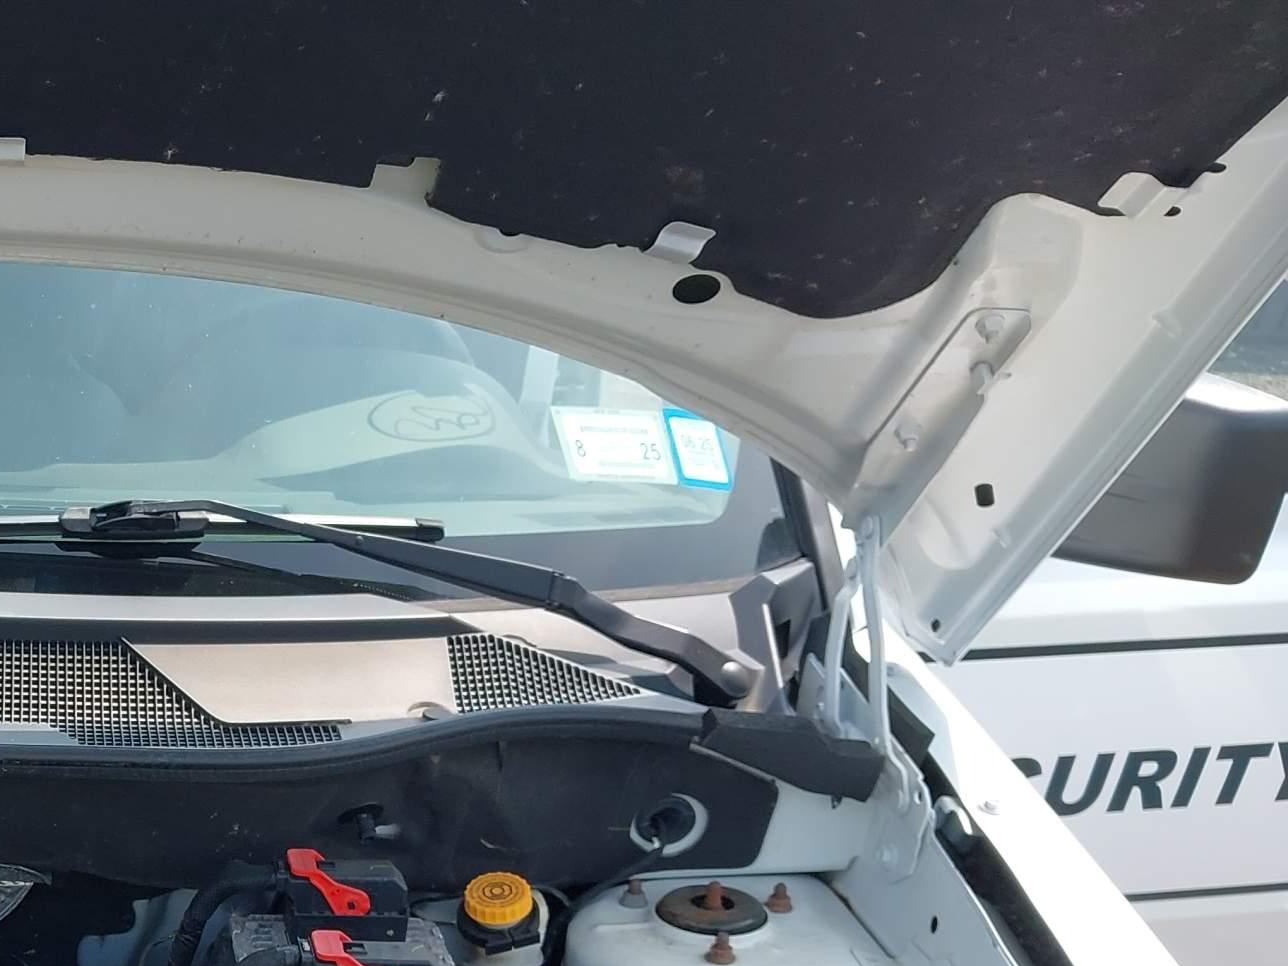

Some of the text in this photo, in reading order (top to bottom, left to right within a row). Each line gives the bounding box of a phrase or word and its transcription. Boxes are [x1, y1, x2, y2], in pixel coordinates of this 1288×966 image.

[575, 439, 662, 461] 8 25
[1009, 741, 1288, 818] URIT
